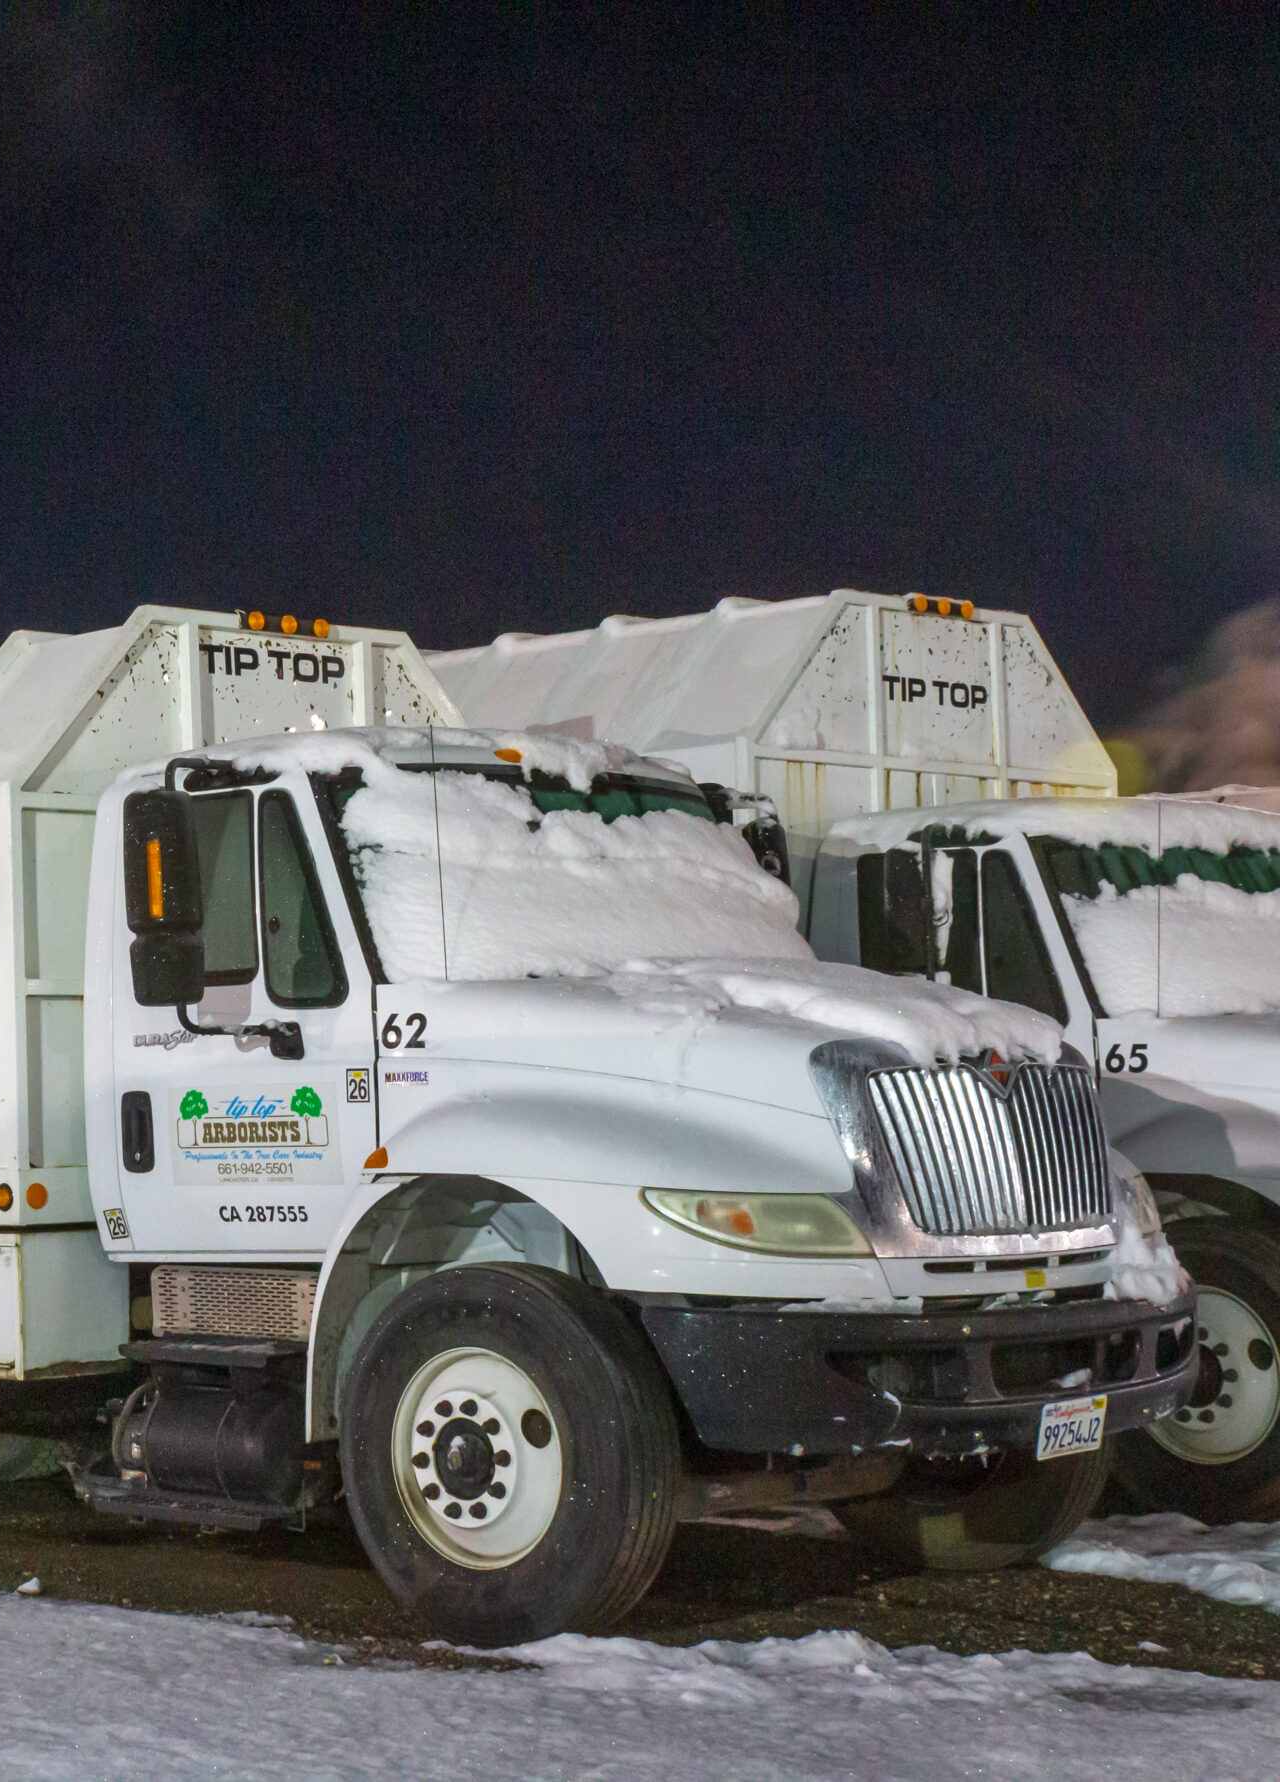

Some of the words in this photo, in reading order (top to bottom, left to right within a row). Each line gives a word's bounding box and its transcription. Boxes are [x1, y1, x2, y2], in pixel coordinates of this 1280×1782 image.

[199, 643, 259, 676] TIP
[267, 649, 345, 684] TOP
[882, 675, 926, 702] TIP
[932, 680, 987, 709] TOP
[381, 1012, 427, 1049] 62
[1105, 1043, 1148, 1074] 65
[349, 1078, 367, 1100] 26
[202, 1120, 301, 1143] ARBORISTS
[217, 1162, 294, 1175] 661-942-5501
[219, 1206, 242, 1222] CA
[247, 1205, 309, 1223] 287555
[108, 1216, 126, 1236] 26
